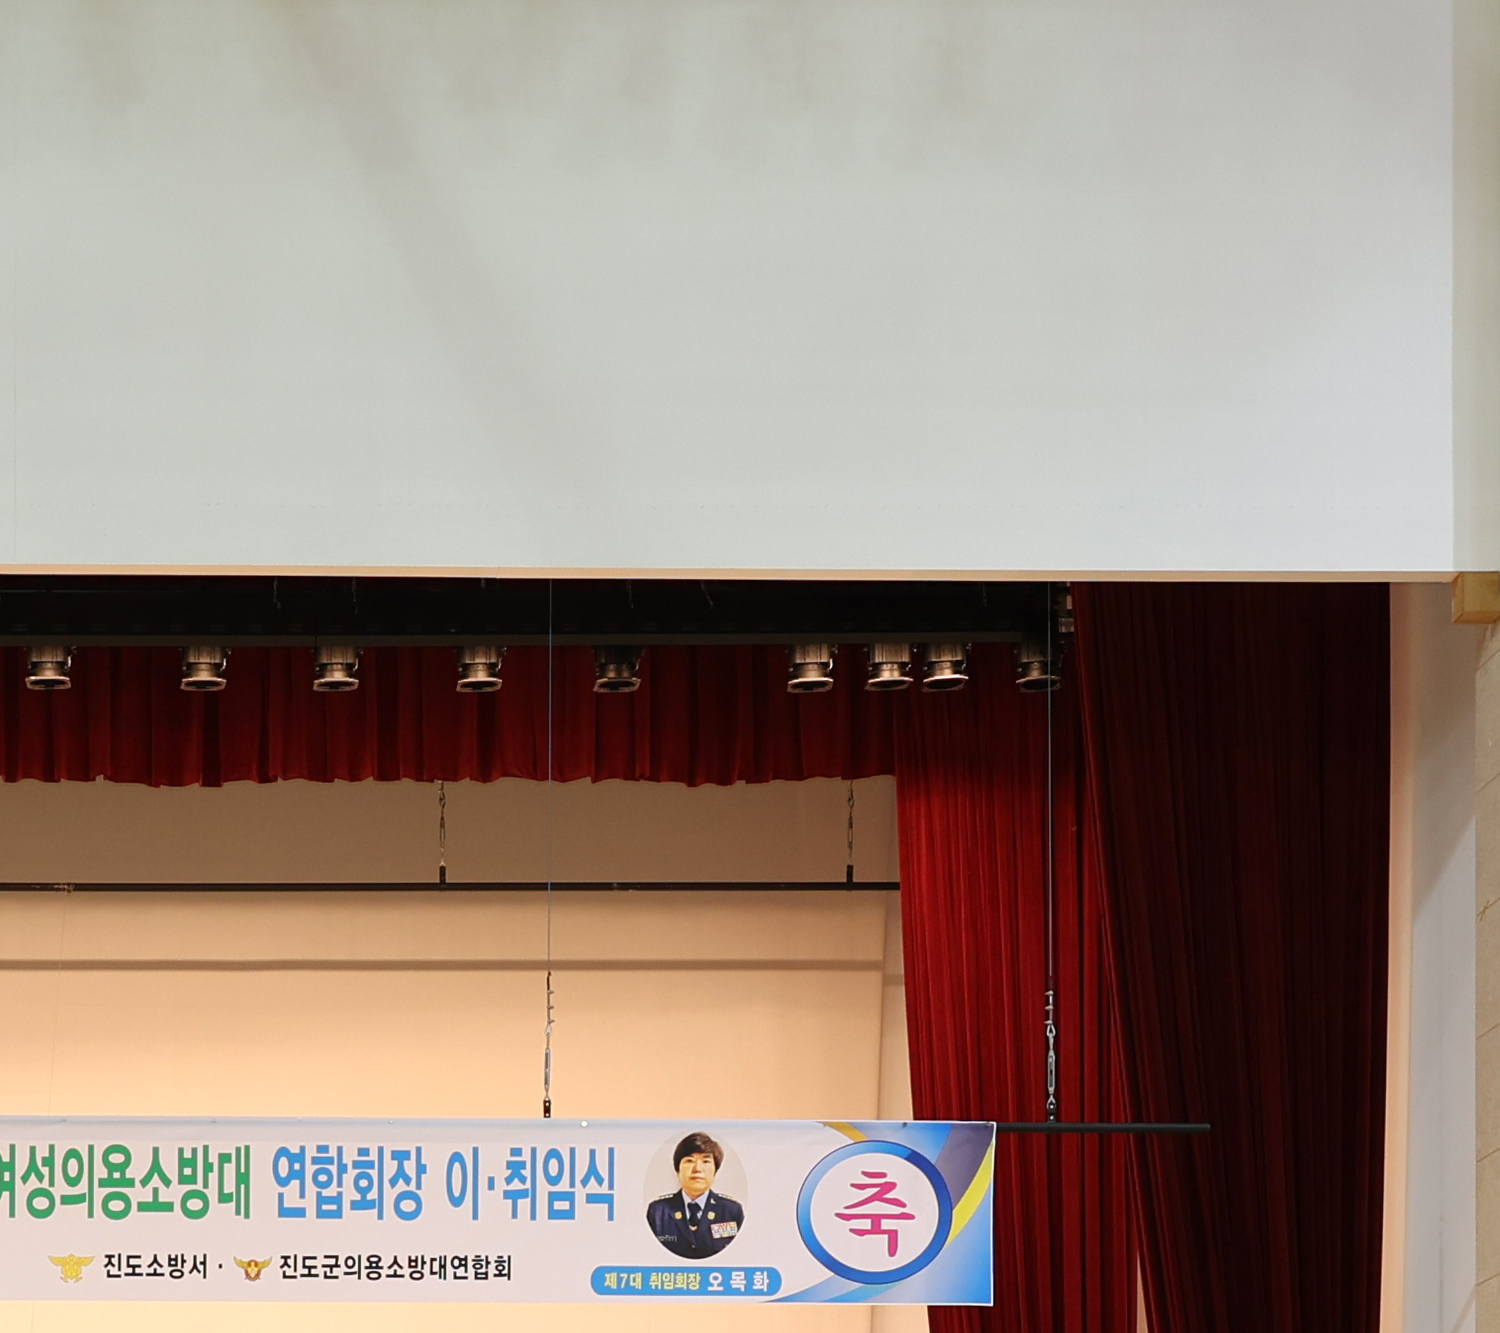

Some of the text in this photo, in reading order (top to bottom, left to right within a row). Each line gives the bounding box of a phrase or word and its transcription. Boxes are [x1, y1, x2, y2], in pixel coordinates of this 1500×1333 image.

[272, 1145, 426, 1222] 연합회장
[834, 1170, 916, 1258] 축
[104, 1252, 513, 1283] 진도소방서 진도군의용소방대연합회
[604, 1271, 642, 1289] 제7대
[649, 1271, 701, 1291] 취임회장
